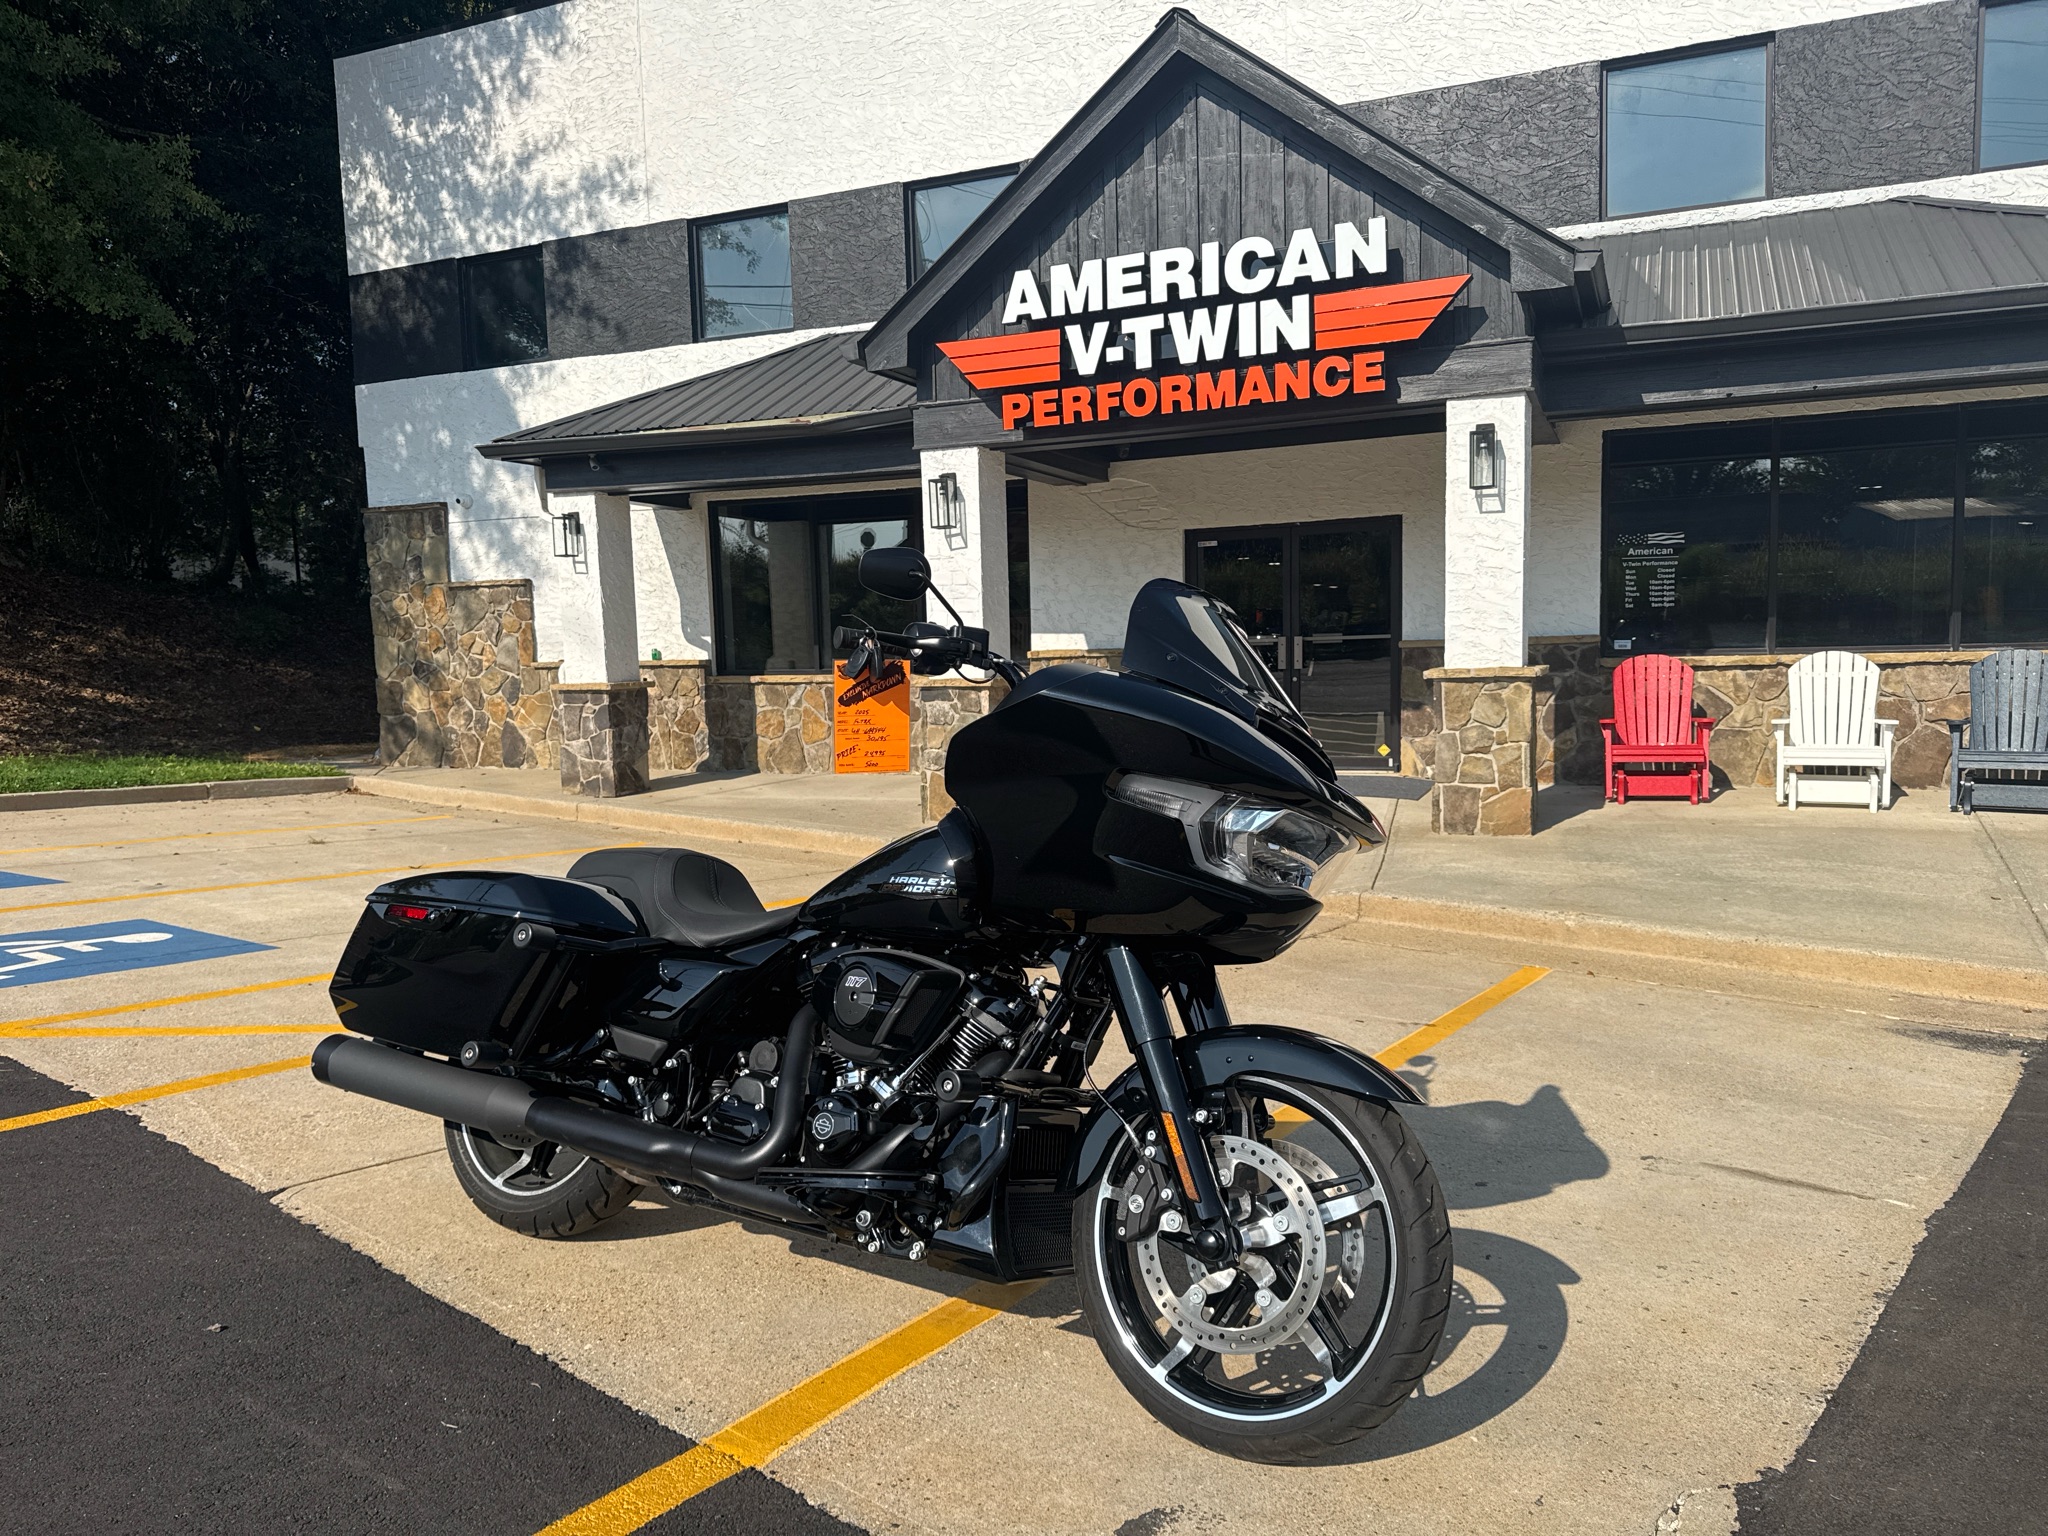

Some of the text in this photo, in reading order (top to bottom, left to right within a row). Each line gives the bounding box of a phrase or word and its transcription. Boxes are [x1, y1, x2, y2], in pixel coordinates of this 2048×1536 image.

[1002, 215, 1388, 324] AMERICAN
[1065, 293, 1310, 376] V-TWIN
[1002, 350, 1386, 430] PERFORMANCE
[1627, 547, 1674, 556] American
[861, 672, 902, 700] MARKDOWN
[845, 975, 868, 988] 117
